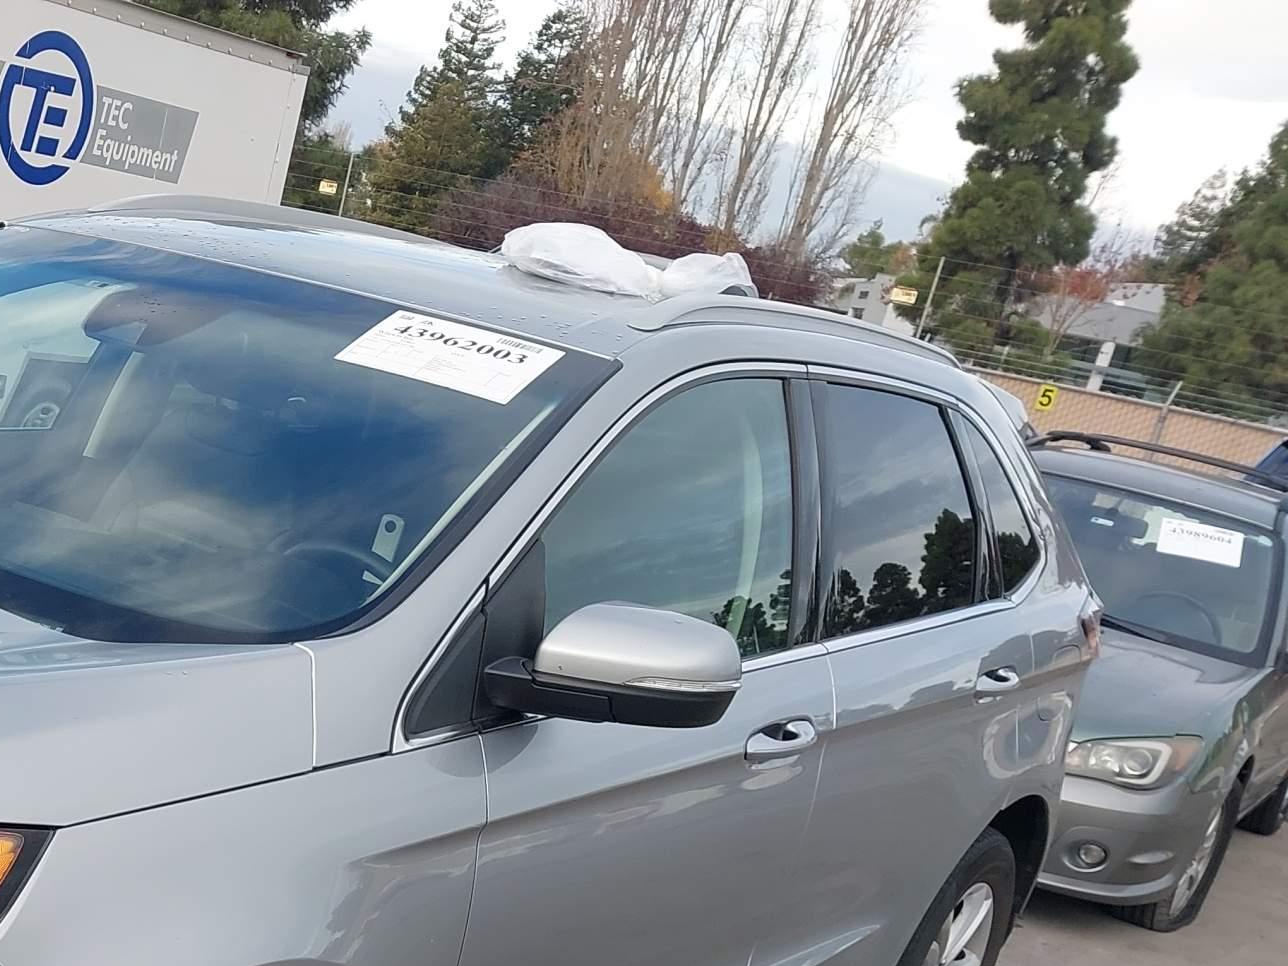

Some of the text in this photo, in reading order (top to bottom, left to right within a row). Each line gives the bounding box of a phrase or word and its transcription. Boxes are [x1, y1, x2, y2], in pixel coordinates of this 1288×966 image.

[99, 96, 134, 130] TEC
[92, 128, 178, 173] Equipment
[393, 324, 529, 365] 43962003
[1038, 388, 1055, 407] 5
